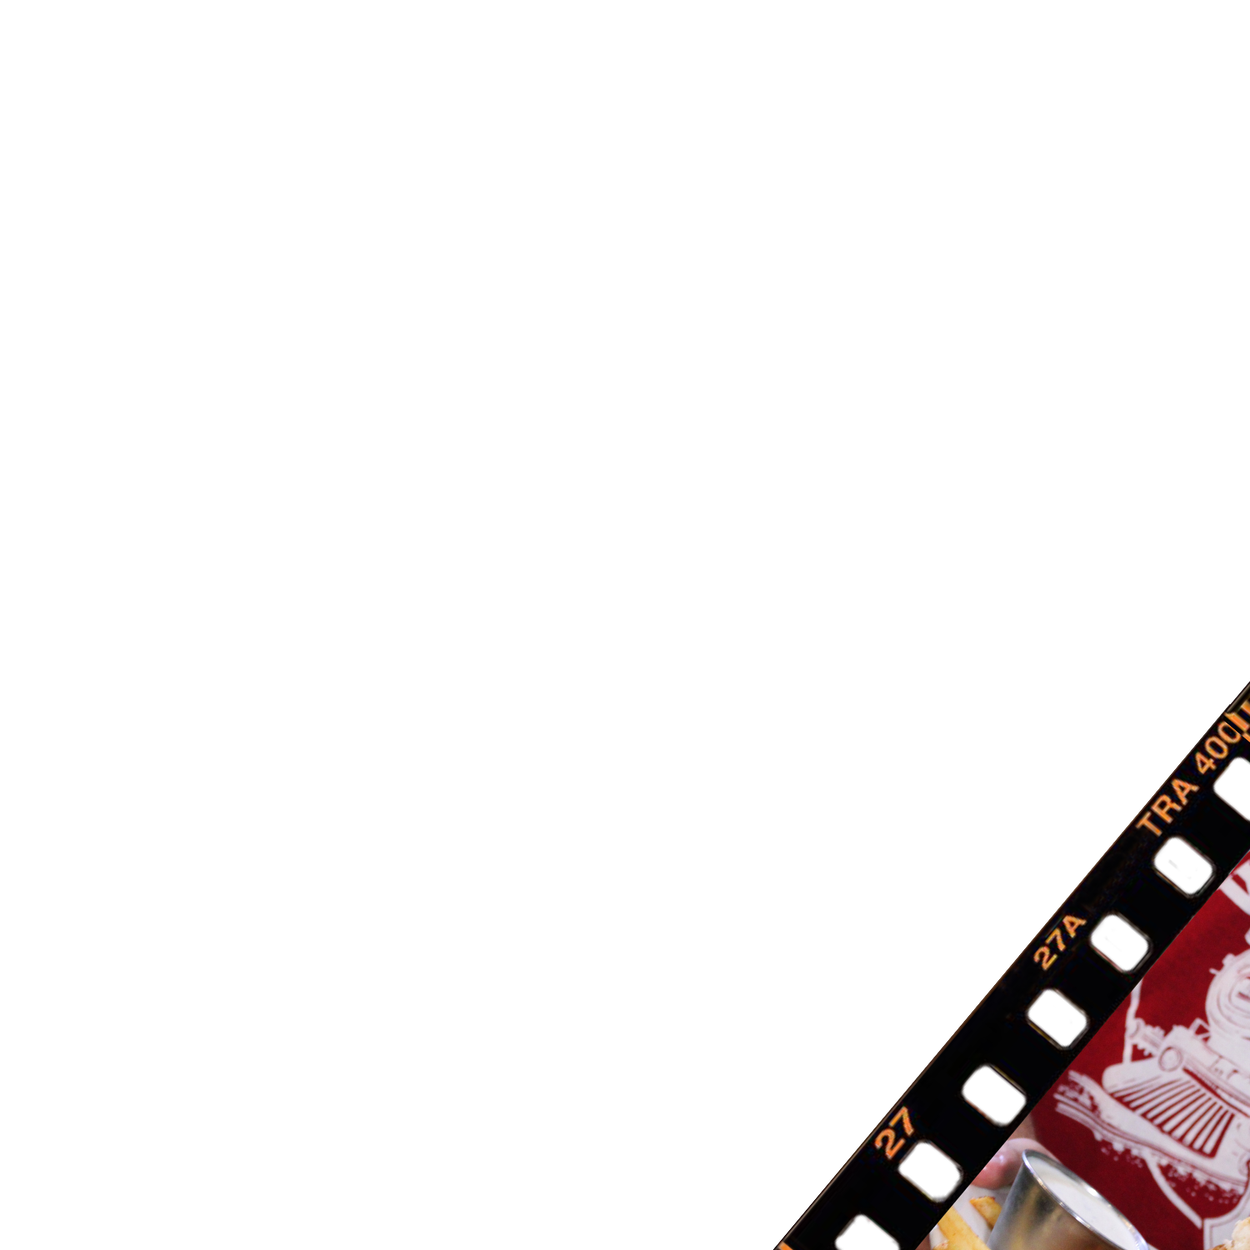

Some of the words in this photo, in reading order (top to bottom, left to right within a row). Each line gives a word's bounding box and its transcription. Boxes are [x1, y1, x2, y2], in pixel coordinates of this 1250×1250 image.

[1135, 778, 1200, 837] TRA
[1194, 720, 1242, 776] 400
[1033, 915, 1087, 970] 27A
[873, 1105, 915, 1158] 27
